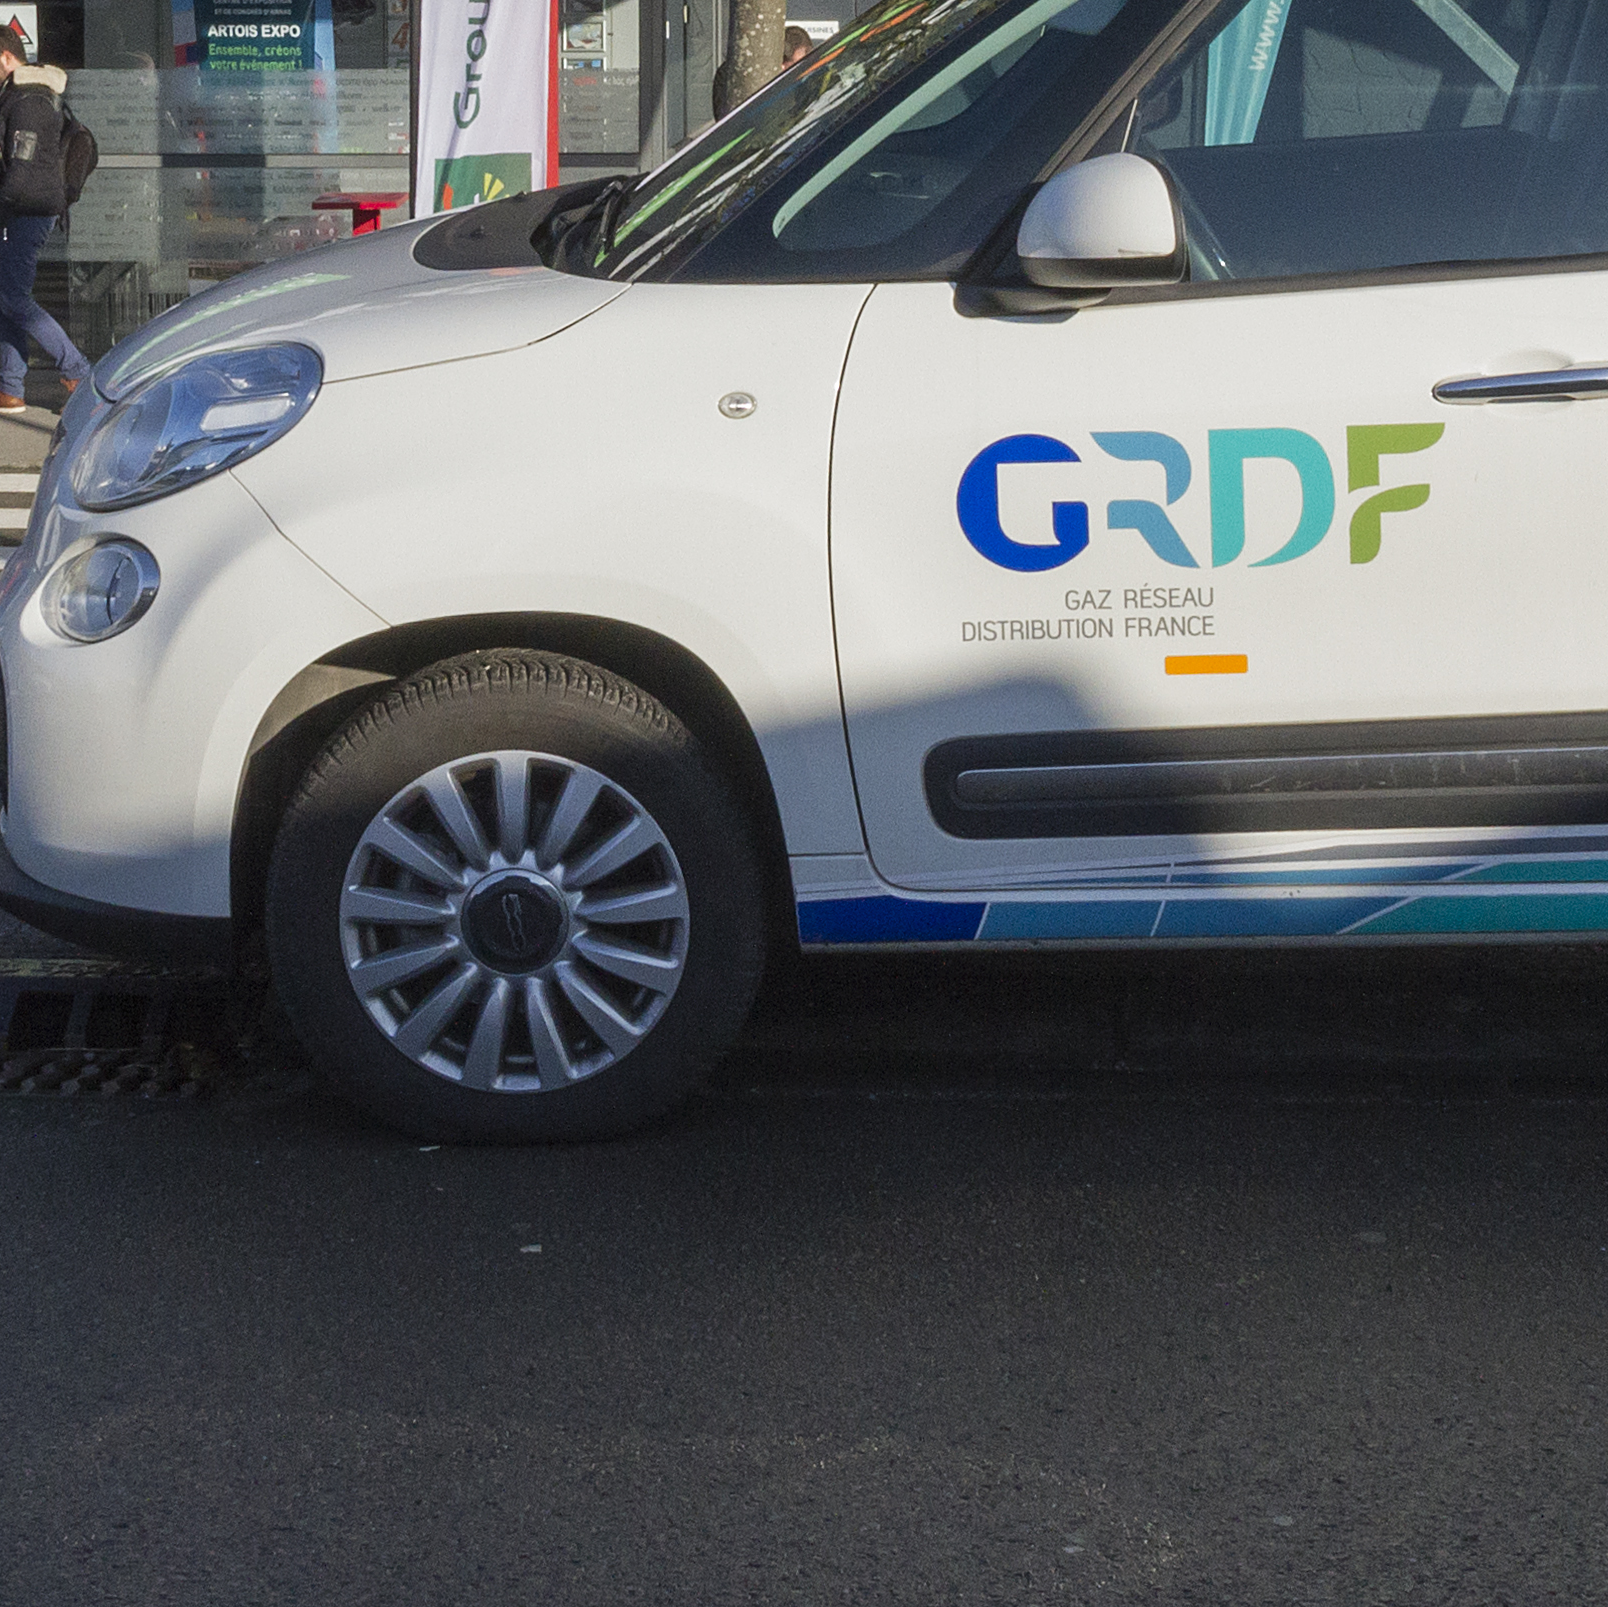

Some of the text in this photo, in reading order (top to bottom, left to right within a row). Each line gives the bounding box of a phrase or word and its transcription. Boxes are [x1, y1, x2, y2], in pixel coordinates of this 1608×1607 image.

[207, 24, 301, 38] ARTOIS EXPO
[208, 42, 302, 57] Ensemble, créons
[209, 60, 237, 71] votre
[956, 422, 1446, 573] GRDF
[1064, 583, 1215, 612] GAZ RÉSEAU
[961, 615, 1215, 643] DISTRIBUTION FRANCE
